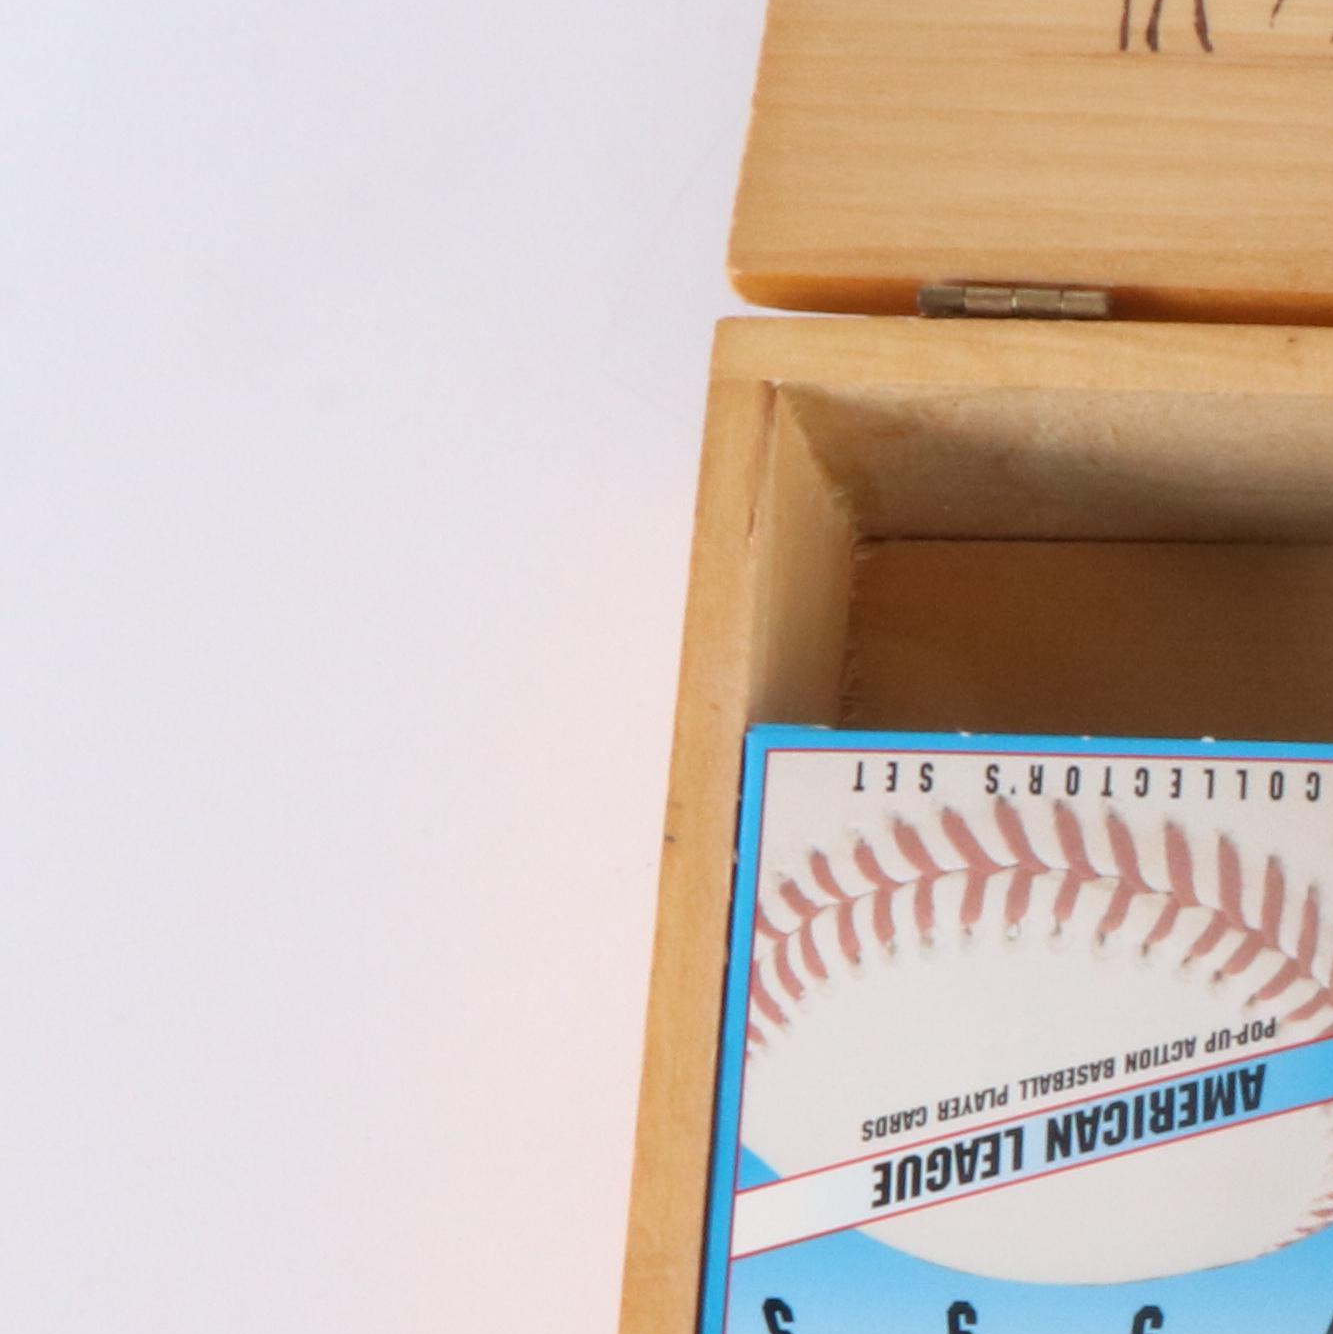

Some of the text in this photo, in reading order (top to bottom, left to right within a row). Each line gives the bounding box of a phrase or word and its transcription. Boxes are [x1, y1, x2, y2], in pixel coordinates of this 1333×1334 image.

[853, 761, 1322, 803] COLLECTOR'S SET
[860, 1016, 1279, 1143] POP-UP ACTION BASEBALL PLAYER CARDS
[870, 1063, 1268, 1209] AMERICAN LEAGUE
